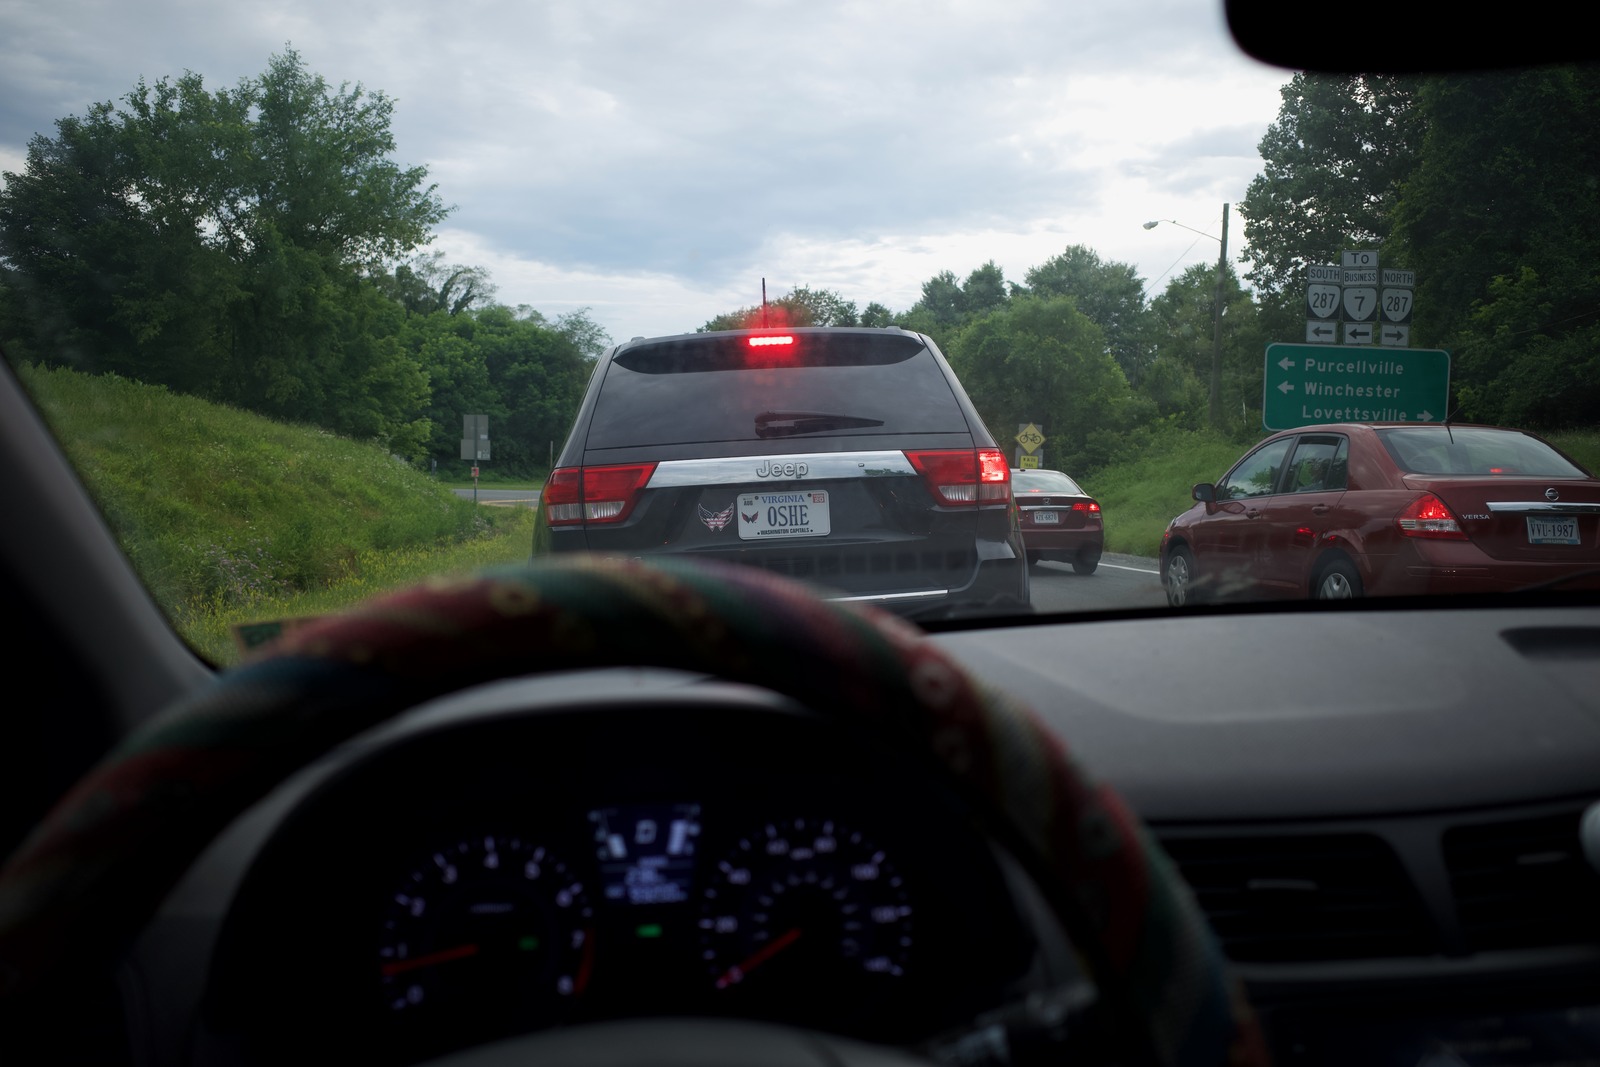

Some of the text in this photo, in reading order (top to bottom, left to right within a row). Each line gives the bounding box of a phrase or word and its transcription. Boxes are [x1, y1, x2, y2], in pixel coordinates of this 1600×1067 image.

[1350, 253, 1369, 264] TO
[1310, 269, 1340, 280] SOUTH
[1344, 272, 1376, 282] BUSINESS
[1384, 272, 1413, 284] NORTH
[1312, 292, 1336, 309] 287
[1354, 296, 1365, 312] 7
[1386, 296, 1408, 313] 287
[1305, 358, 1404, 375] Purcellville
[1304, 382, 1401, 398] Winchester
[1302, 405, 1407, 422] Lovettsville
[756, 460, 809, 478] Jeep
[762, 495, 804, 503] VIRGINIA
[768, 505, 809, 526] OSHE
